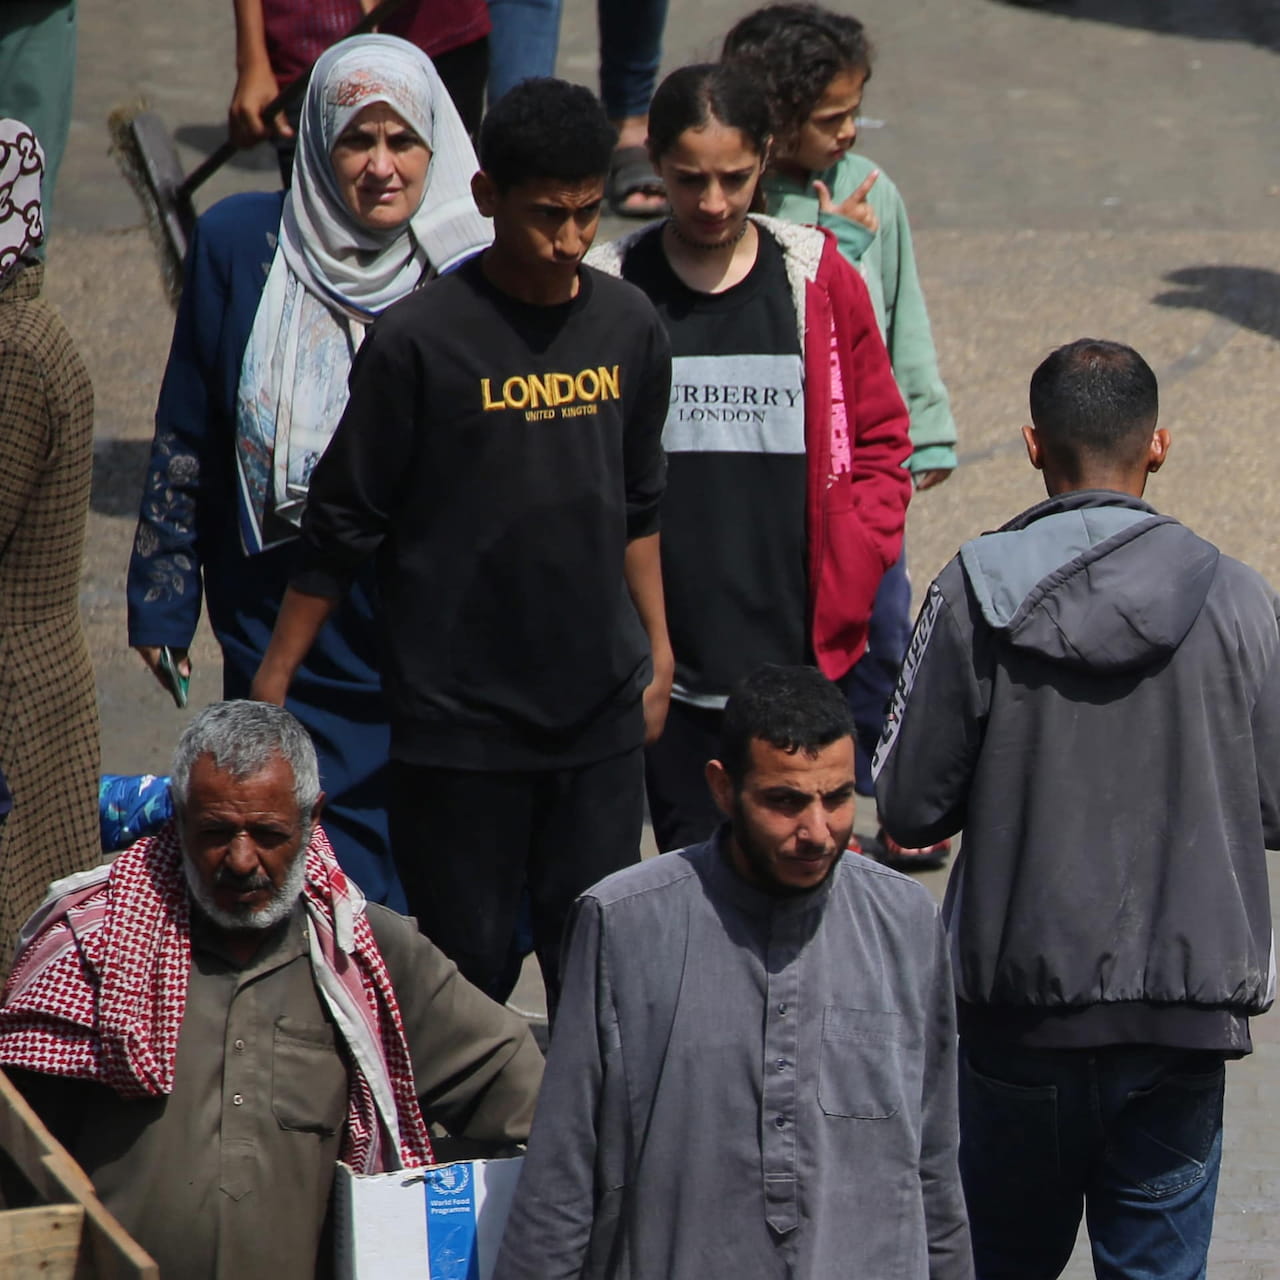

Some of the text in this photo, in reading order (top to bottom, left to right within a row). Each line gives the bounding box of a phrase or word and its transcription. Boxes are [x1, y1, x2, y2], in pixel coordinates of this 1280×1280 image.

[481, 365, 620, 411] LONDON
[525, 409, 555, 422] UNITED
[680, 408, 766, 423] LONDON
[431, 1207, 470, 1215] Programme
